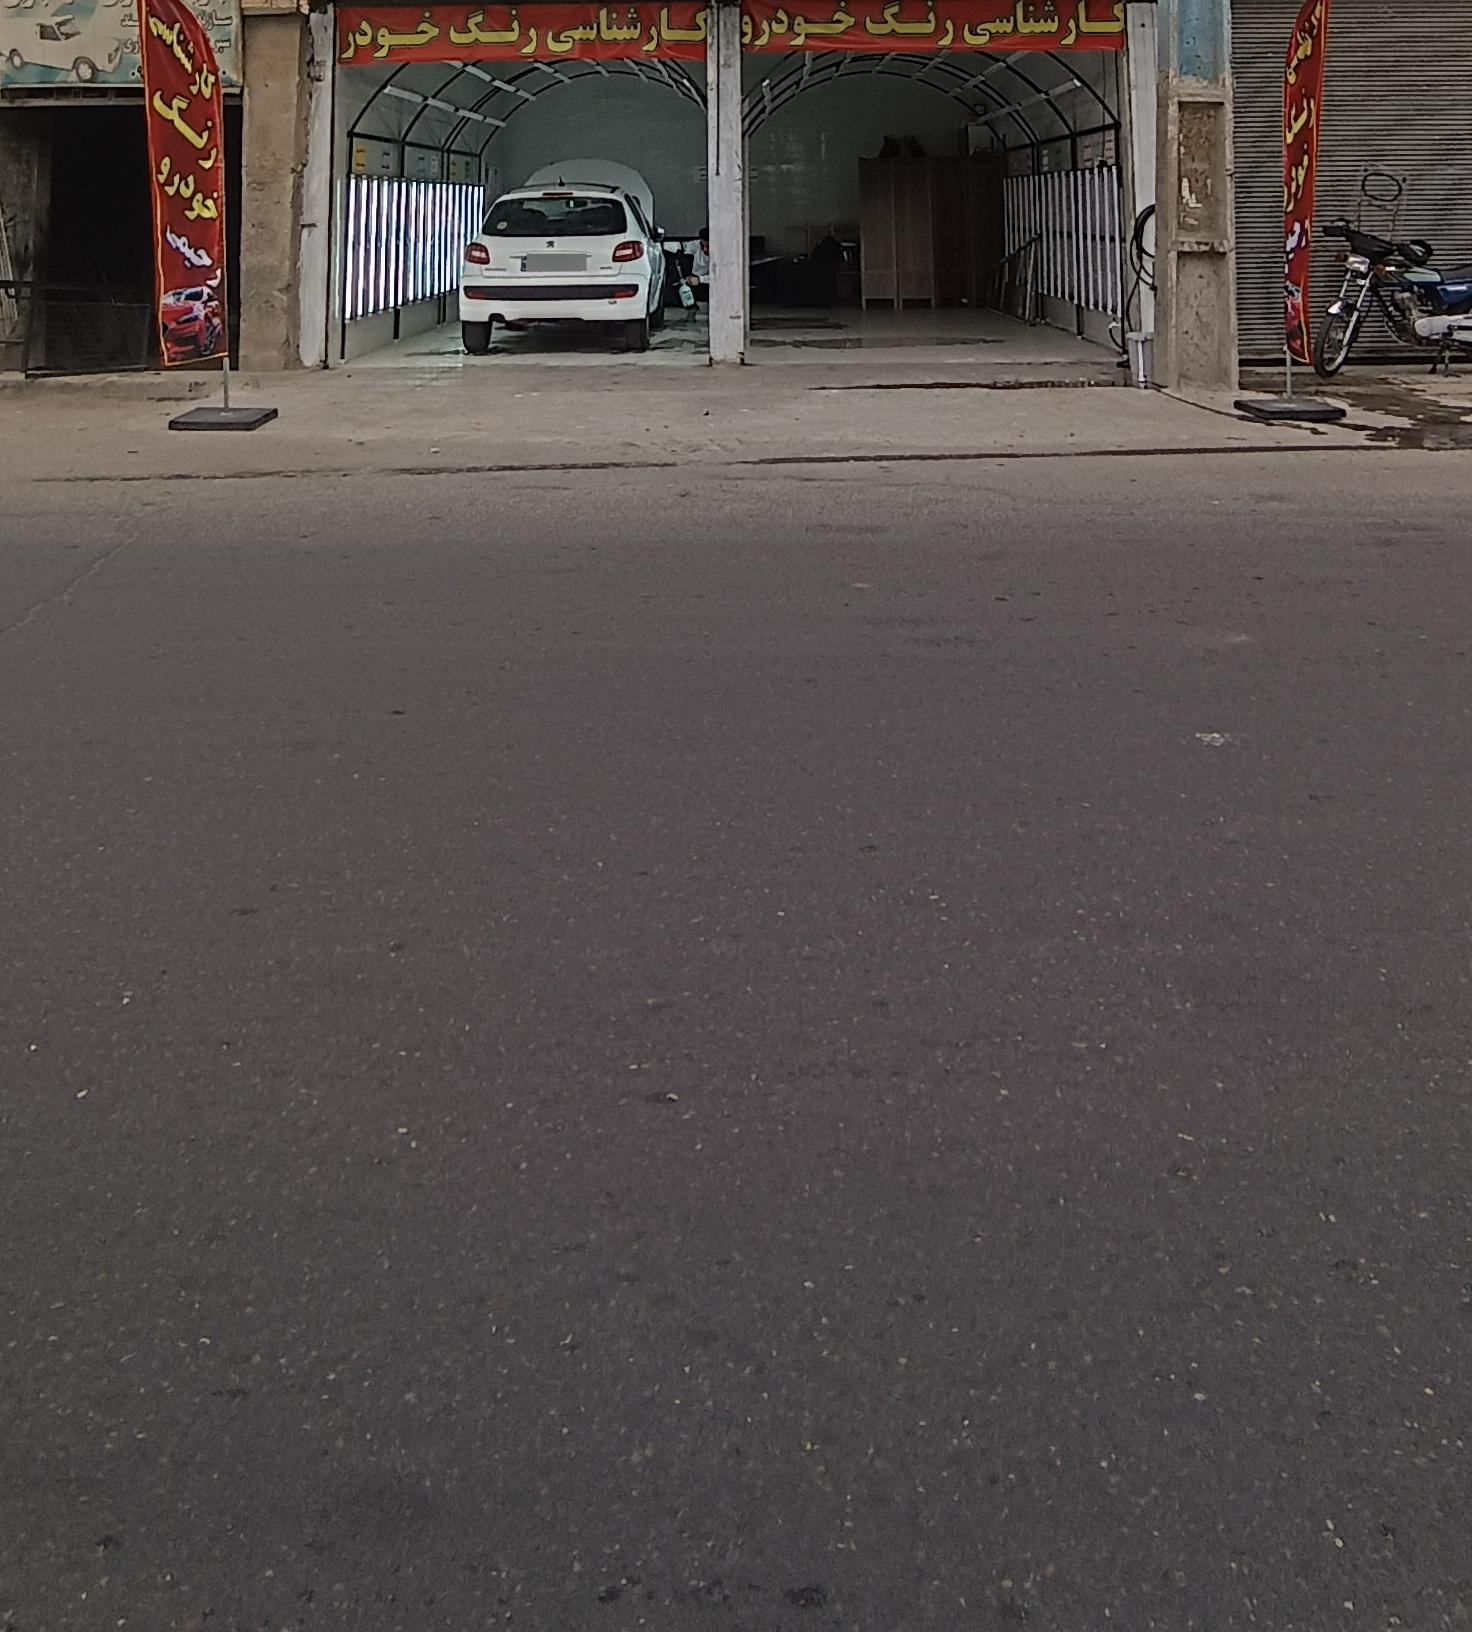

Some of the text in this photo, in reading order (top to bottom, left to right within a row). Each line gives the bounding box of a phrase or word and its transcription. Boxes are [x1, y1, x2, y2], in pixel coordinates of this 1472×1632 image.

[339, 6, 707, 60] کارشناسی رنگ خودر
[740, 0, 856, 47] خودرو
[865, 0, 954, 47] رنگ
